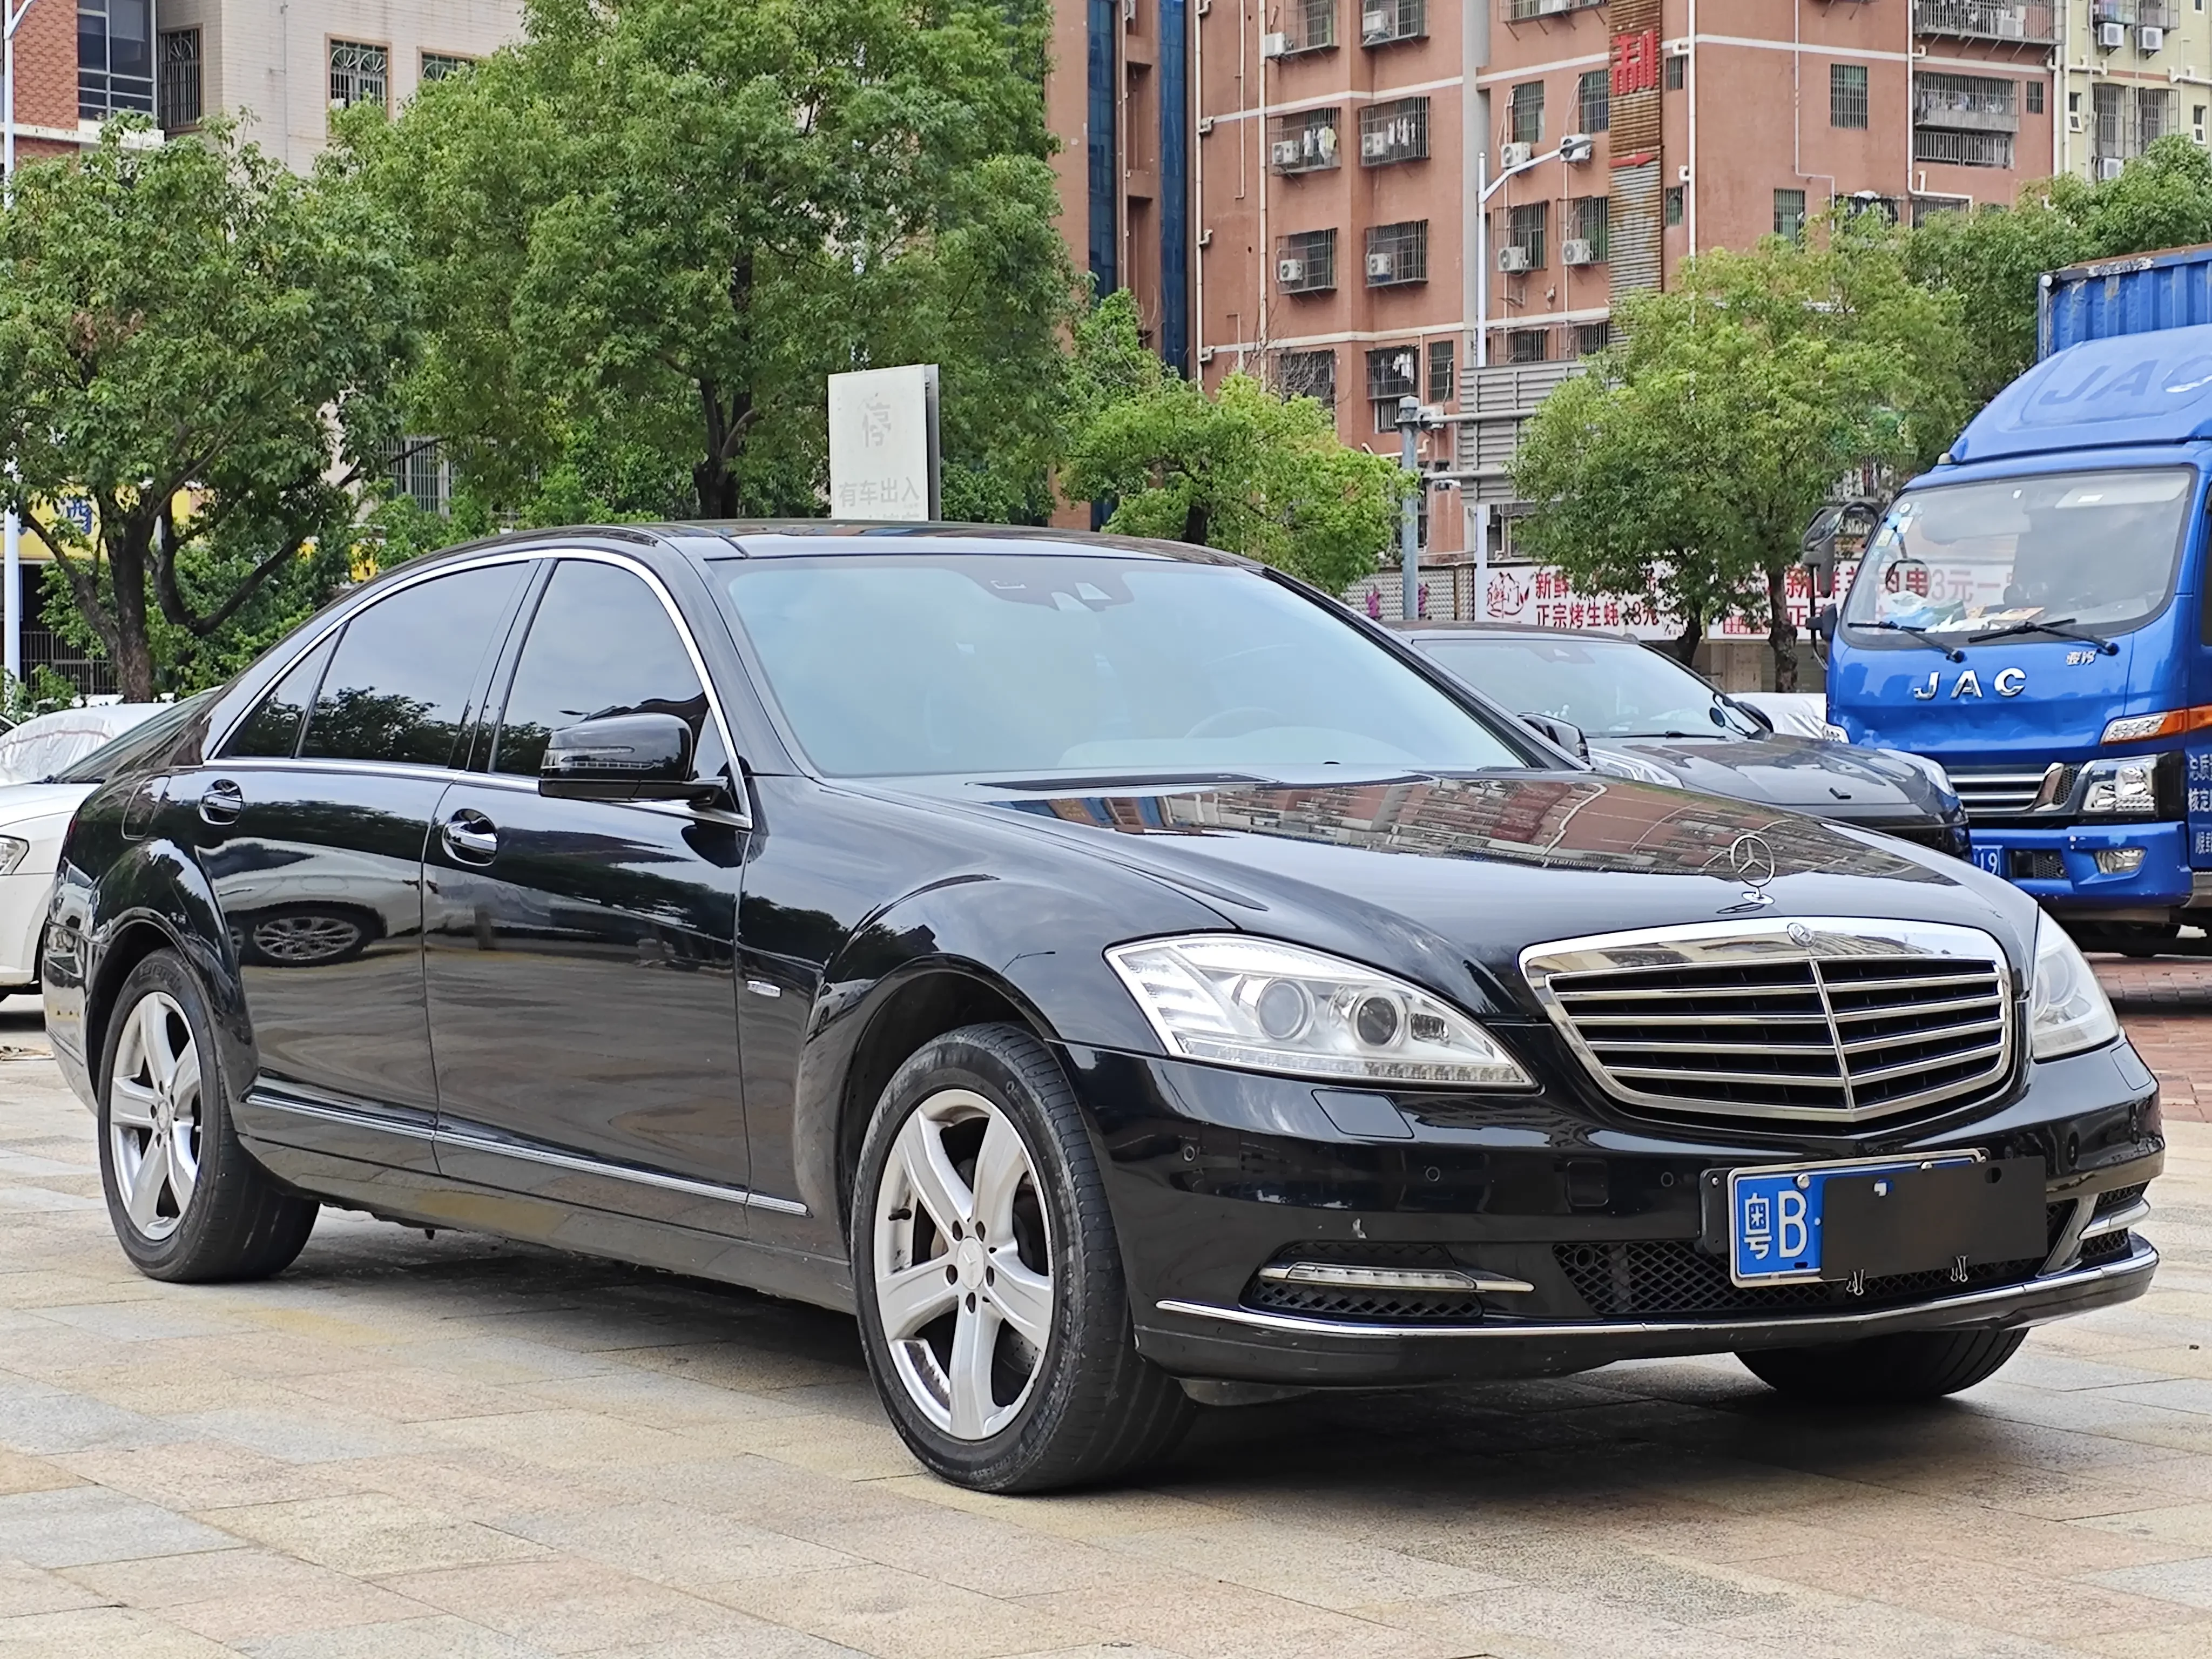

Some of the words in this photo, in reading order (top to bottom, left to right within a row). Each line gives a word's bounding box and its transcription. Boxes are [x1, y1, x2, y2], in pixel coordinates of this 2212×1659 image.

[839, 476, 920, 508] 有车出入
[1913, 667, 2026, 700] JAC
